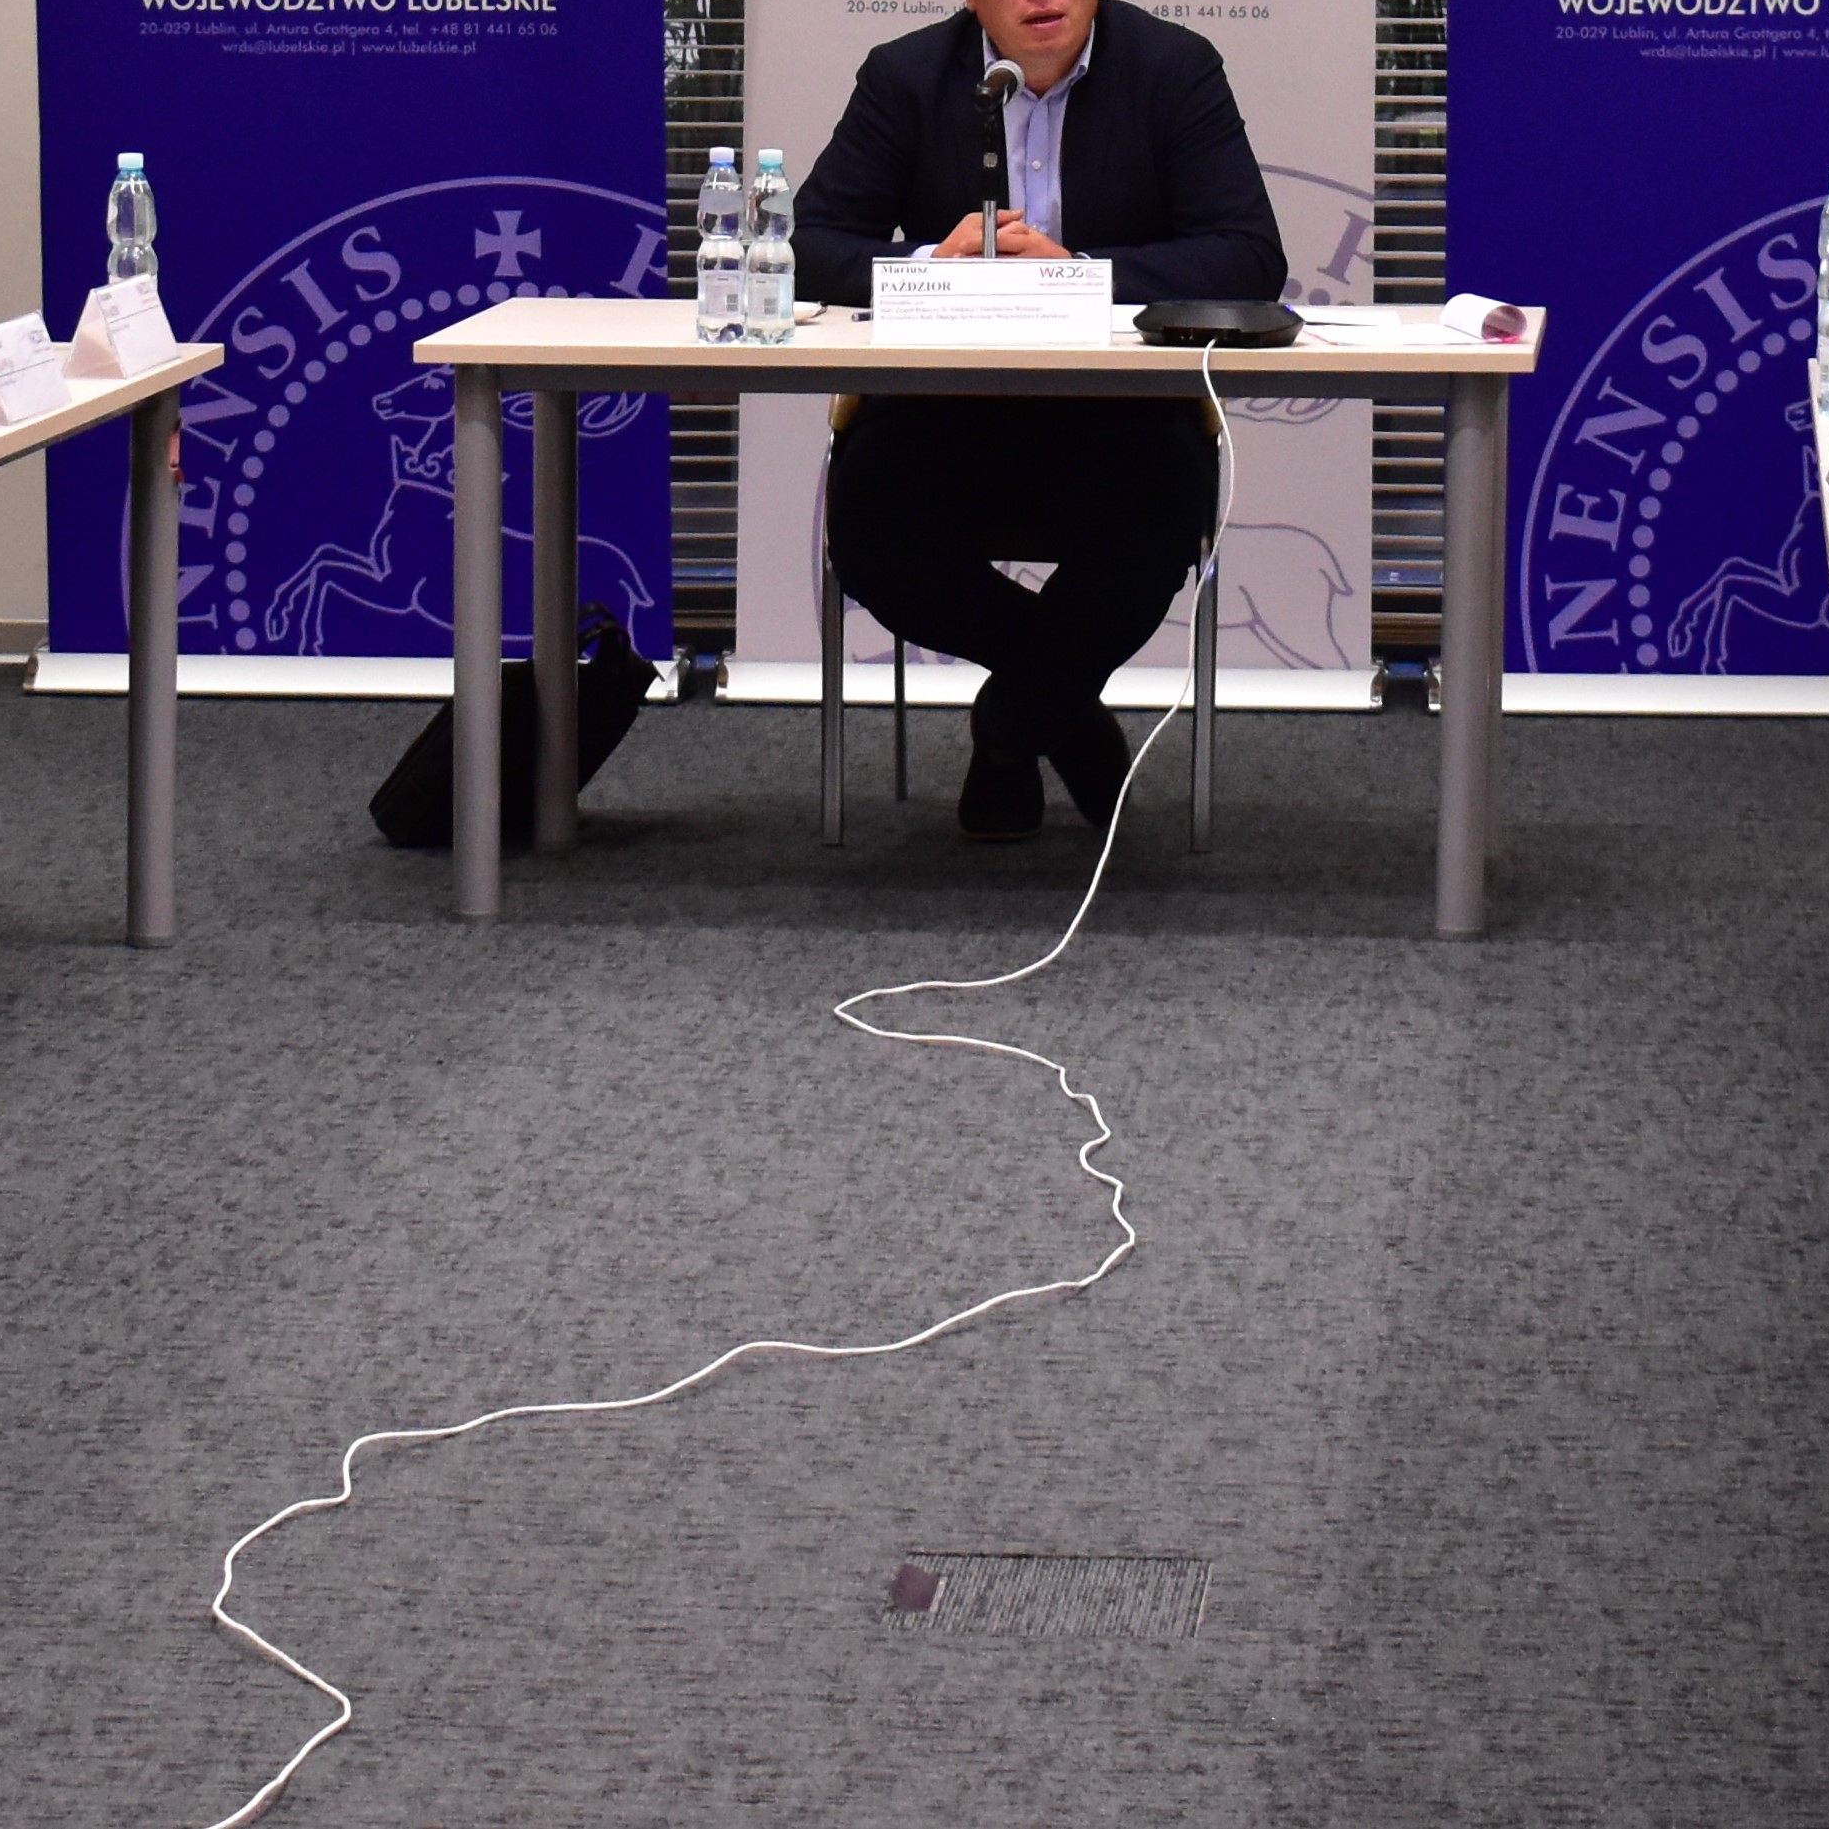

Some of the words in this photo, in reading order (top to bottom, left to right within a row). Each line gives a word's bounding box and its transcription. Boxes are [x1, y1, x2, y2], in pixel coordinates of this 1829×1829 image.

[846, 0, 898, 13] 20-029
[903, 0, 948, 15] Lublin,
[1174, 4, 1191, 17] 81
[1197, 5, 1222, 18] 441
[1229, 5, 1247, 19] 65
[1251, 5, 1270, 19] 06
[139, 22, 192, 36] 20-029
[195, 21, 241, 37] Lublin,
[266, 22, 309, 36] Artura
[429, 22, 459, 36] +48
[463, 22, 480, 36] 81
[486, 22, 512, 36] 441
[518, 22, 536, 36] 65
[539, 22, 558, 36] 06
[1555, 26, 1608, 40] 20-029
[1612, 26, 1659, 41] Lublin,
[1686, 27, 1729, 40] Artura
[221, 40, 346, 56] wrds@lubelskie.pl
[362, 40, 477, 56] www.lubelskie.pl
[1639, 44, 1767, 60] wrds@lubelskie.pl
[881, 264, 929, 274] Mariusz
[881, 278, 951, 292] PAŹDZIOR
